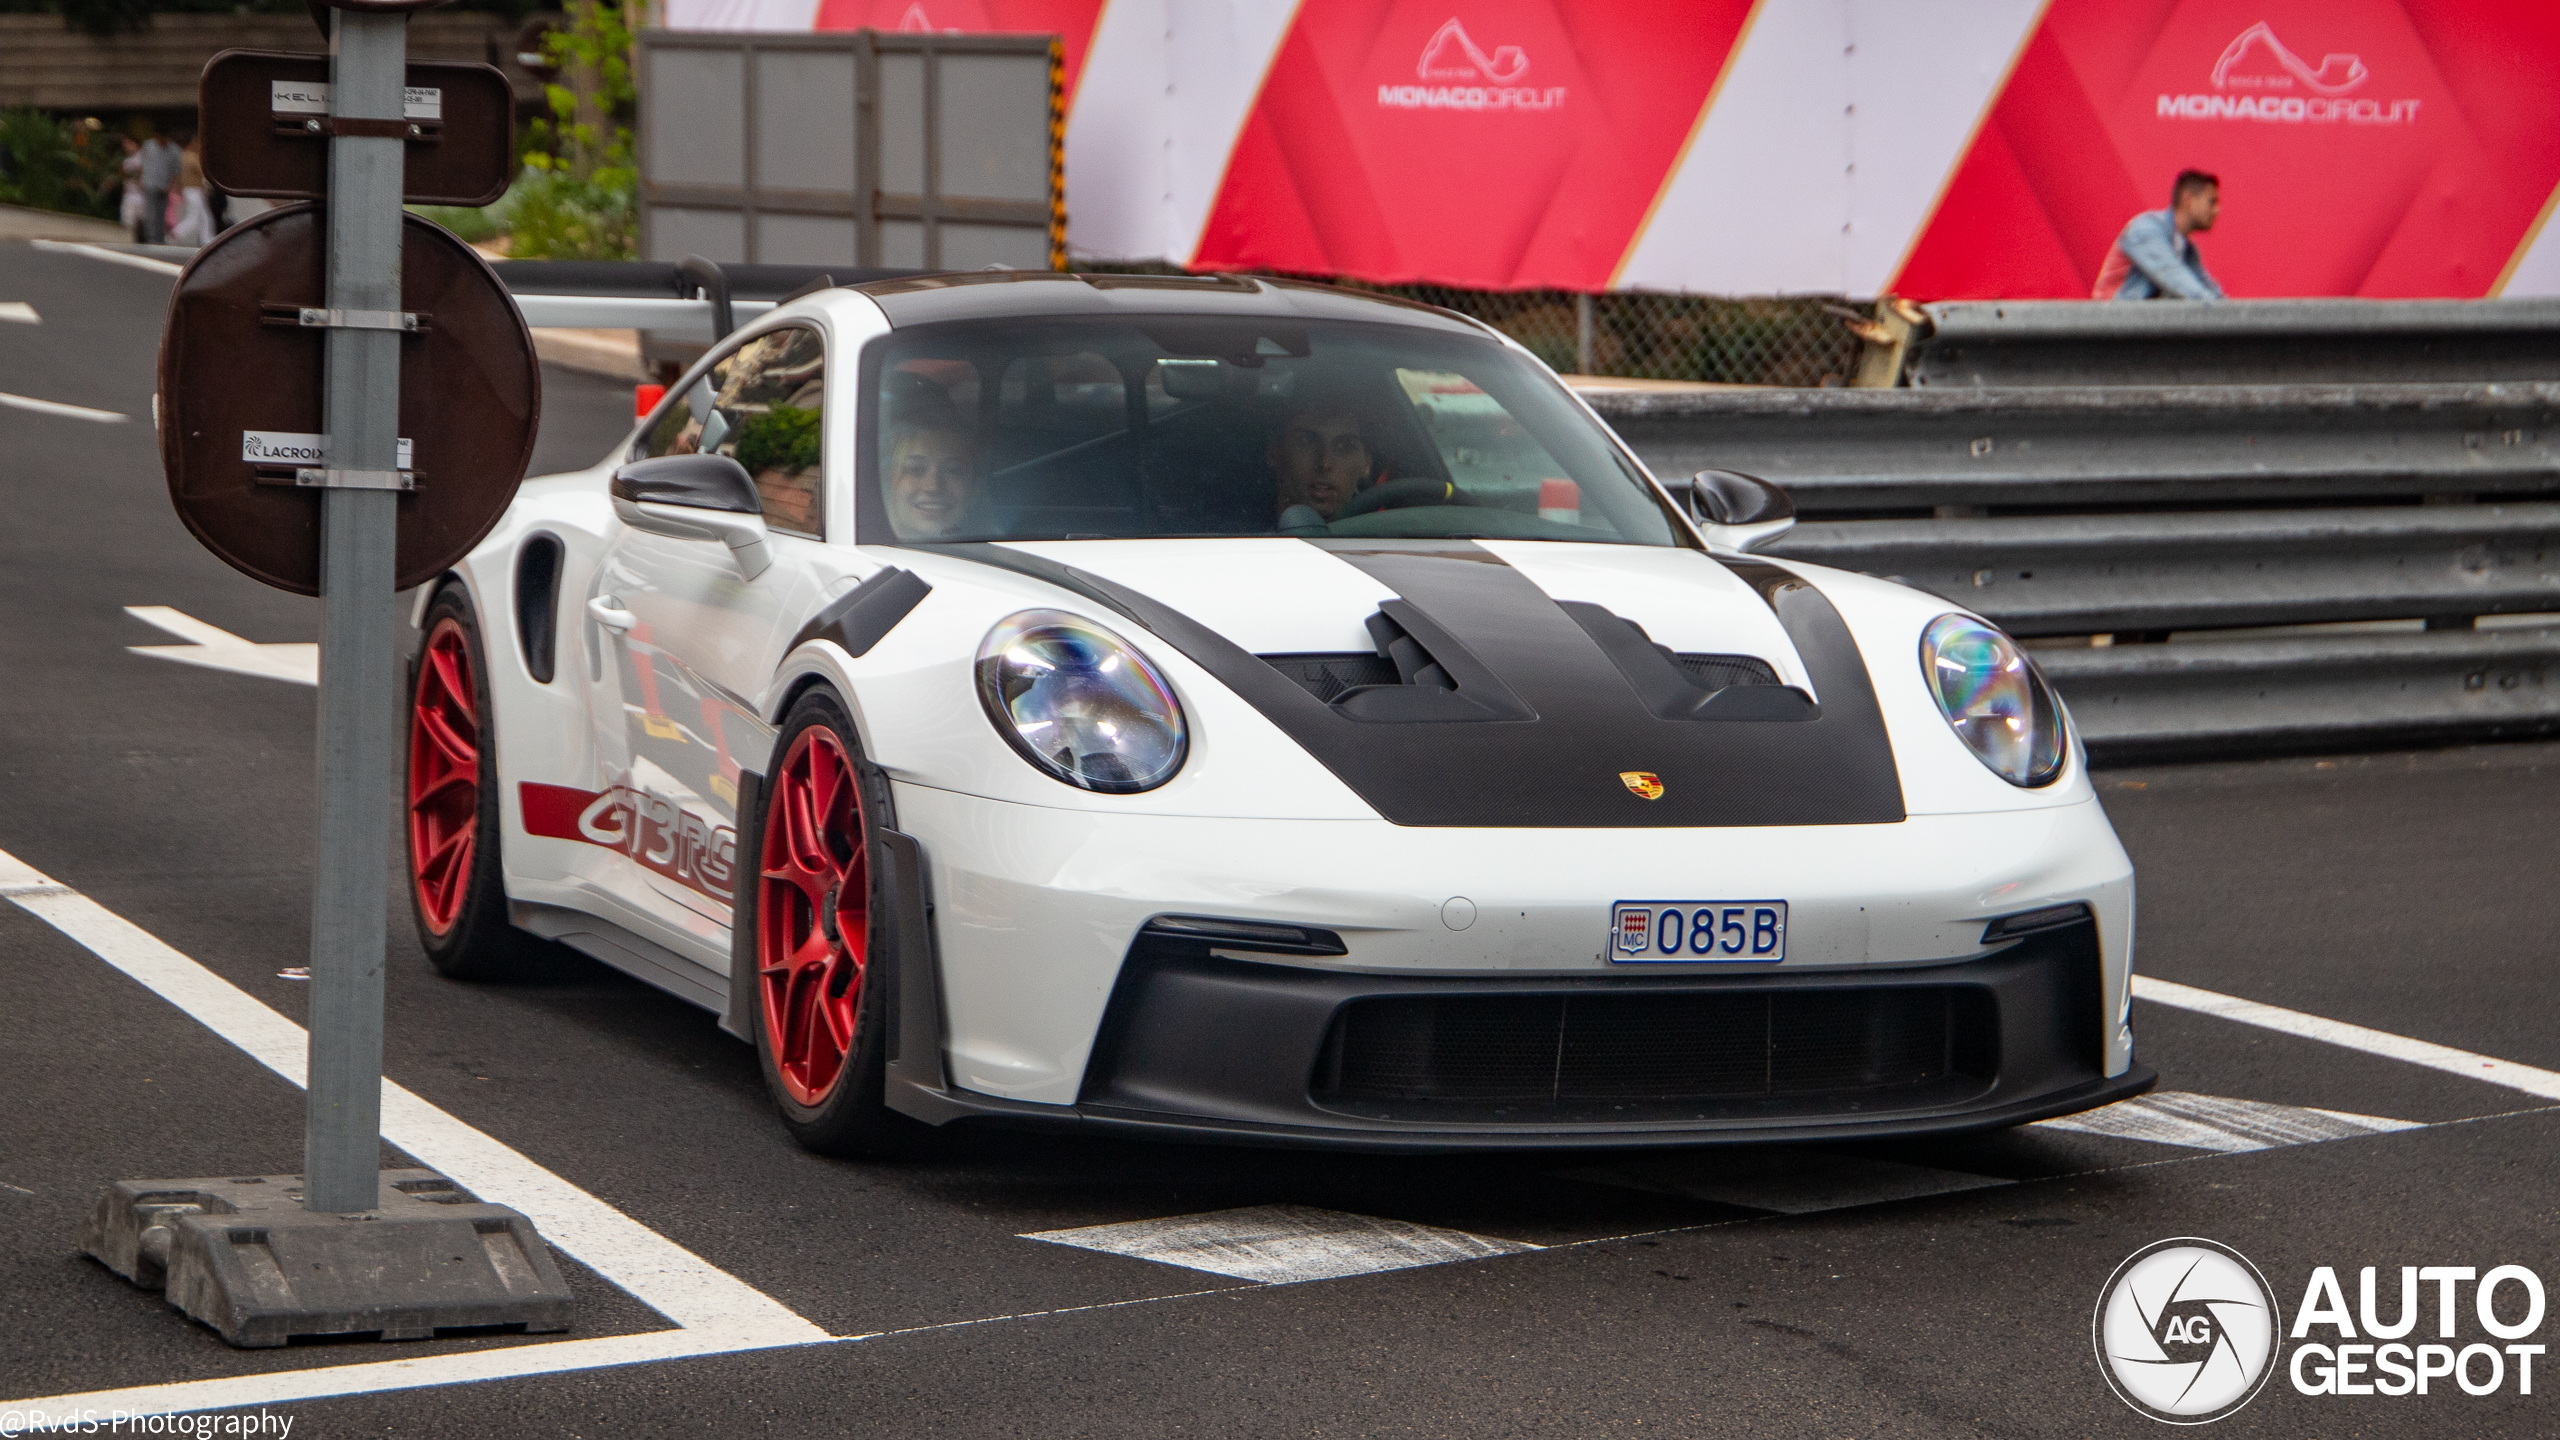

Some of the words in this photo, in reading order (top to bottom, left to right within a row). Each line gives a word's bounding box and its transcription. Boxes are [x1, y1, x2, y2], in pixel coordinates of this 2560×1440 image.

[275, 92, 331, 103] KELI
[263, 445, 323, 459] LACROIX
[1623, 933, 1644, 946] MC
[1657, 907, 1777, 955] 085B
